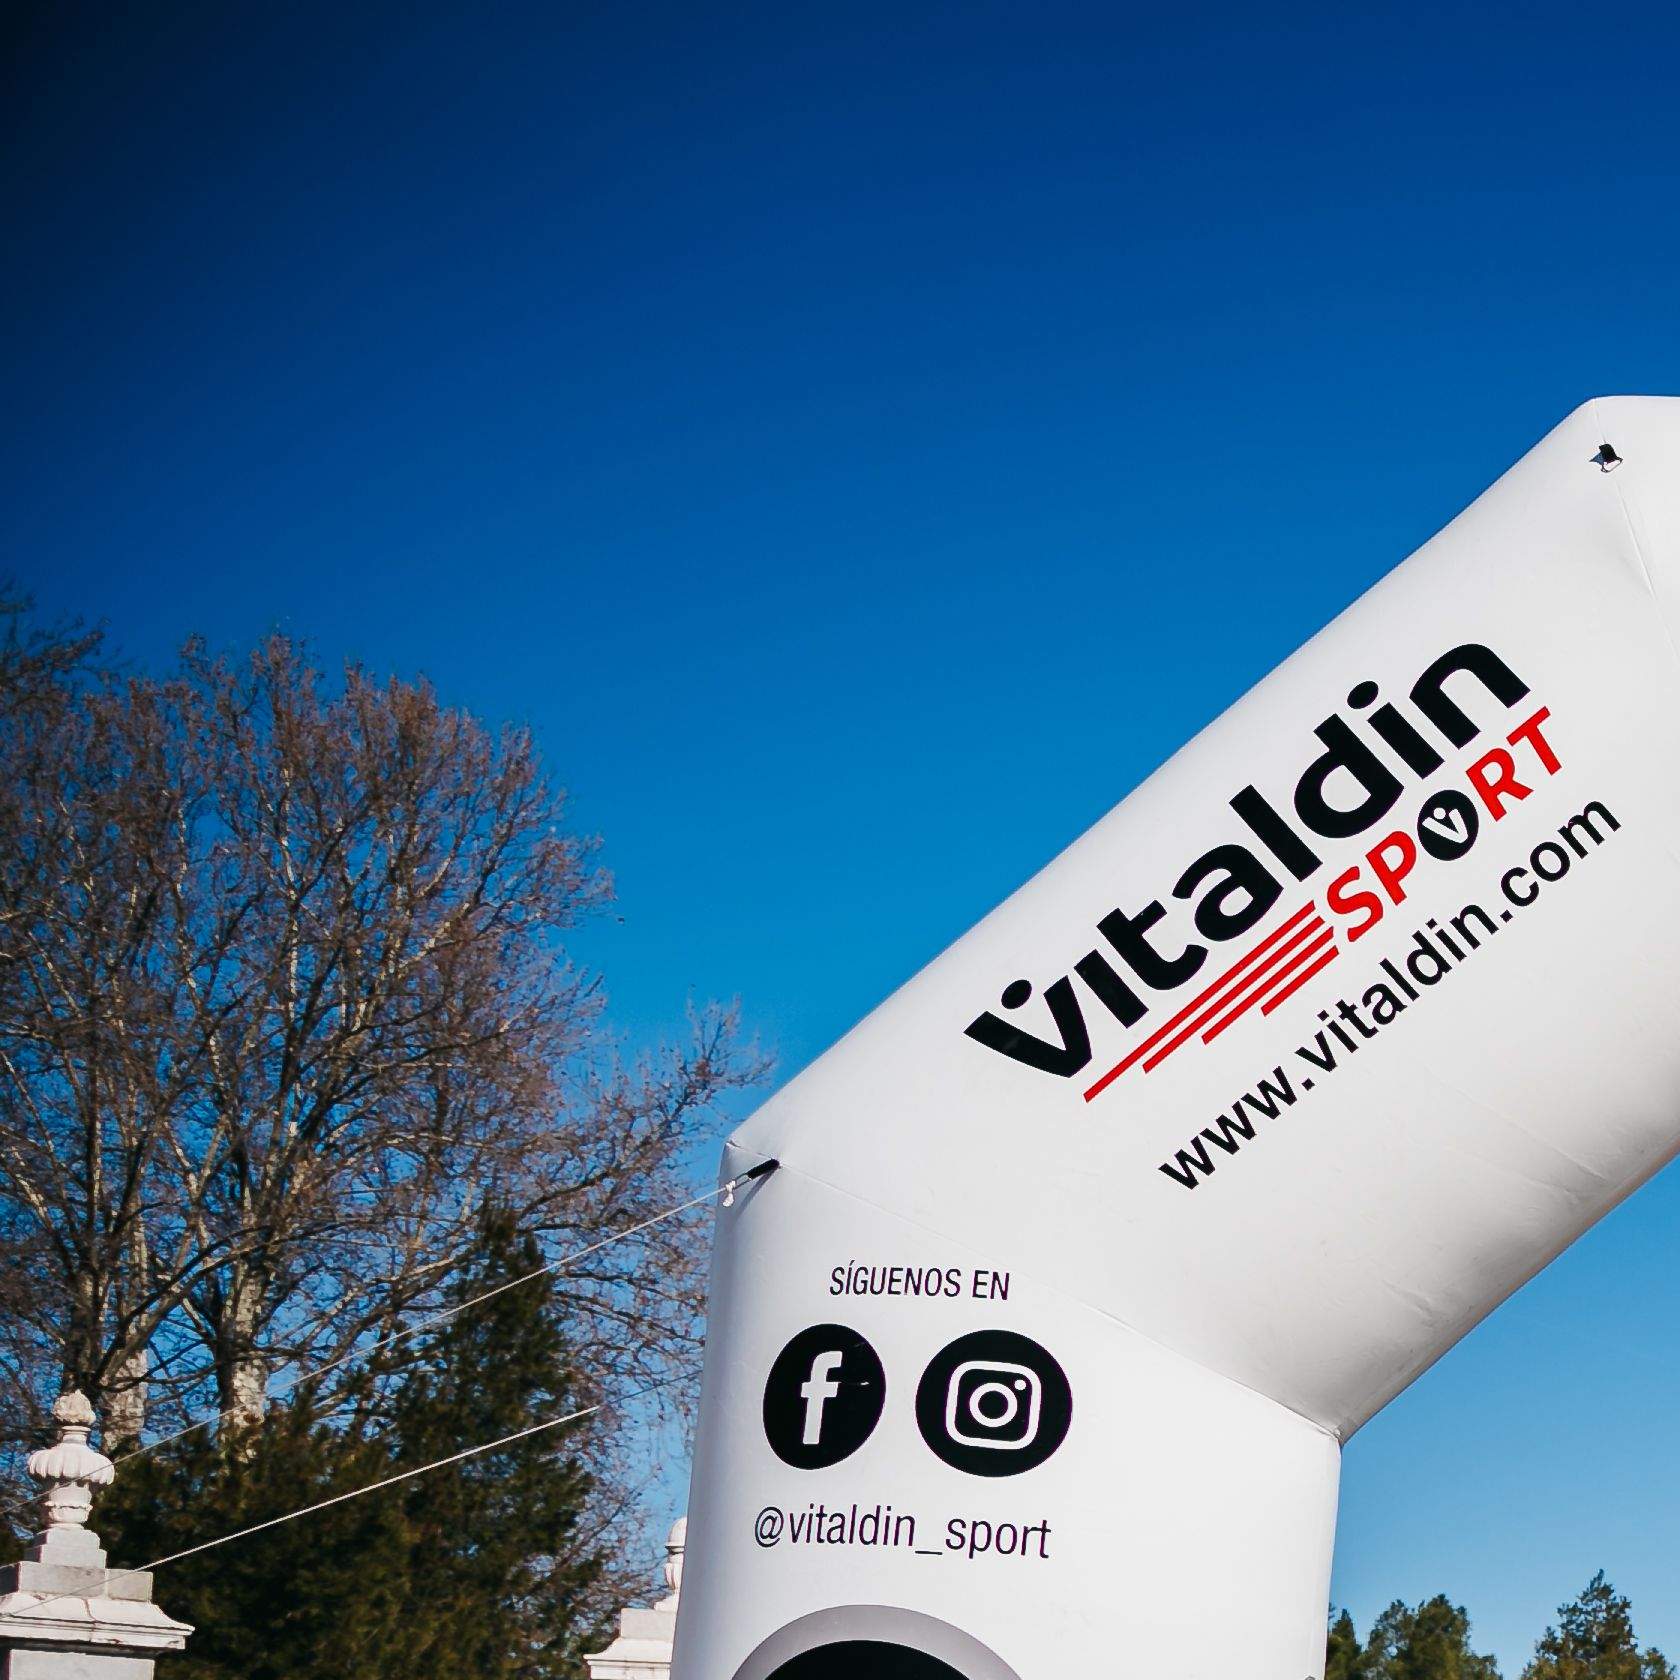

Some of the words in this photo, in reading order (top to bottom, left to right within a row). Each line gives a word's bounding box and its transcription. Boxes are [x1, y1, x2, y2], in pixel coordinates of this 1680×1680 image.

[1327, 705, 1563, 942] SPORT
[1157, 801, 1621, 1190] www.vitaldin.com
[829, 1261, 962, 1302] SÍGUENOS
[967, 1269, 1011, 1302] EN
[755, 1502, 1052, 1559] @vitaldin_sport
